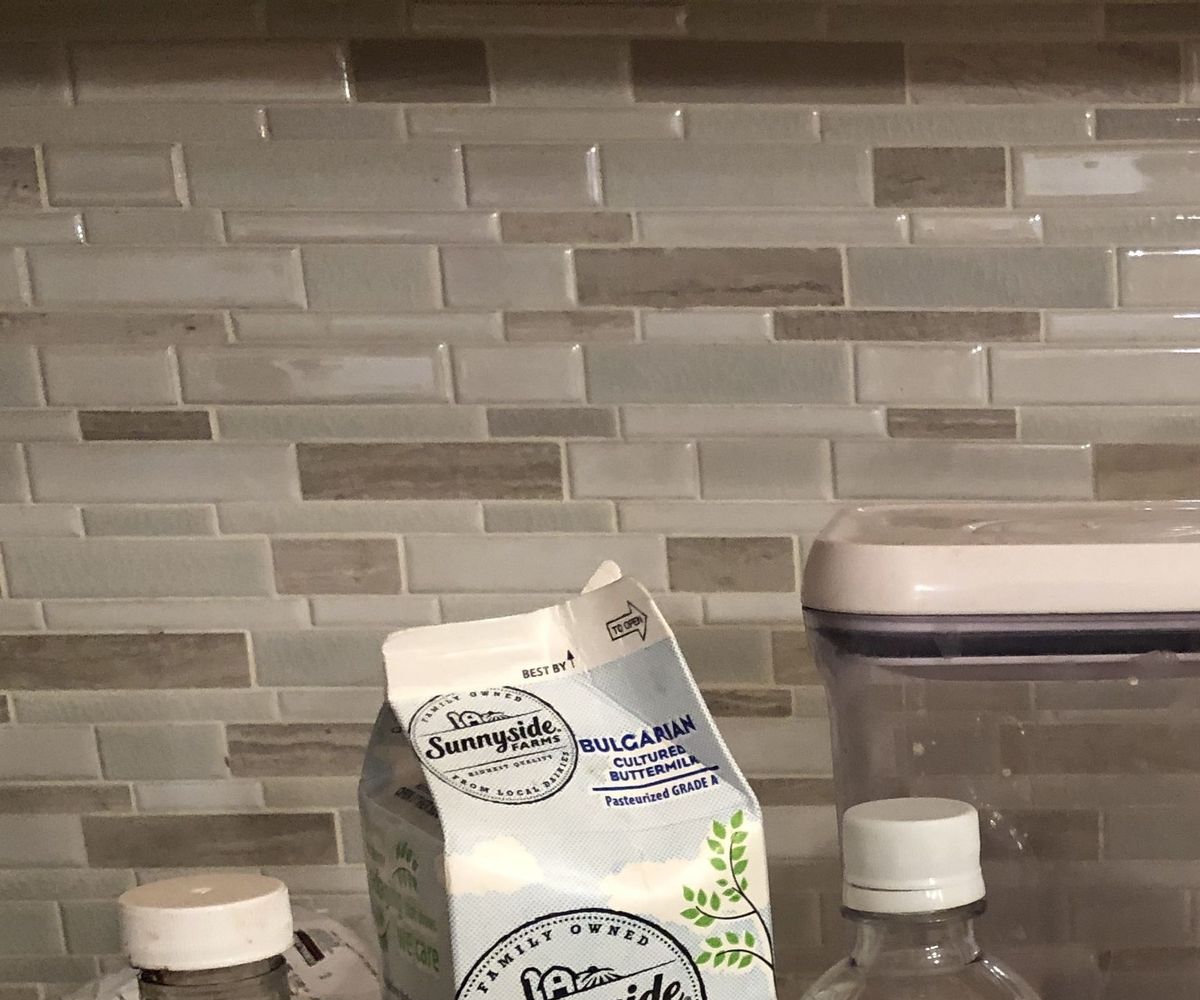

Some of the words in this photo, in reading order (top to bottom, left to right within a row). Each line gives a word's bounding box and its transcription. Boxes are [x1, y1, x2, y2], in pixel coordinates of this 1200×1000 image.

[522, 665, 550, 679] BEST
[551, 661, 567, 675] BY
[425, 715, 557, 760] Sunnyside
[512, 735, 562, 751] FARMS
[578, 713, 698, 754] BULGARIAN
[608, 755, 700, 782] BUTTERMILK
[613, 745, 687, 768] CULTURED
[452, 775, 491, 793] FROM
[497, 785, 540, 797] LOCAL
[605, 787, 670, 807] Pasteurized
[672, 778, 708, 798] GRADE
[477, 929, 554, 994] FAMILY
[570, 922, 651, 948] OWNED
